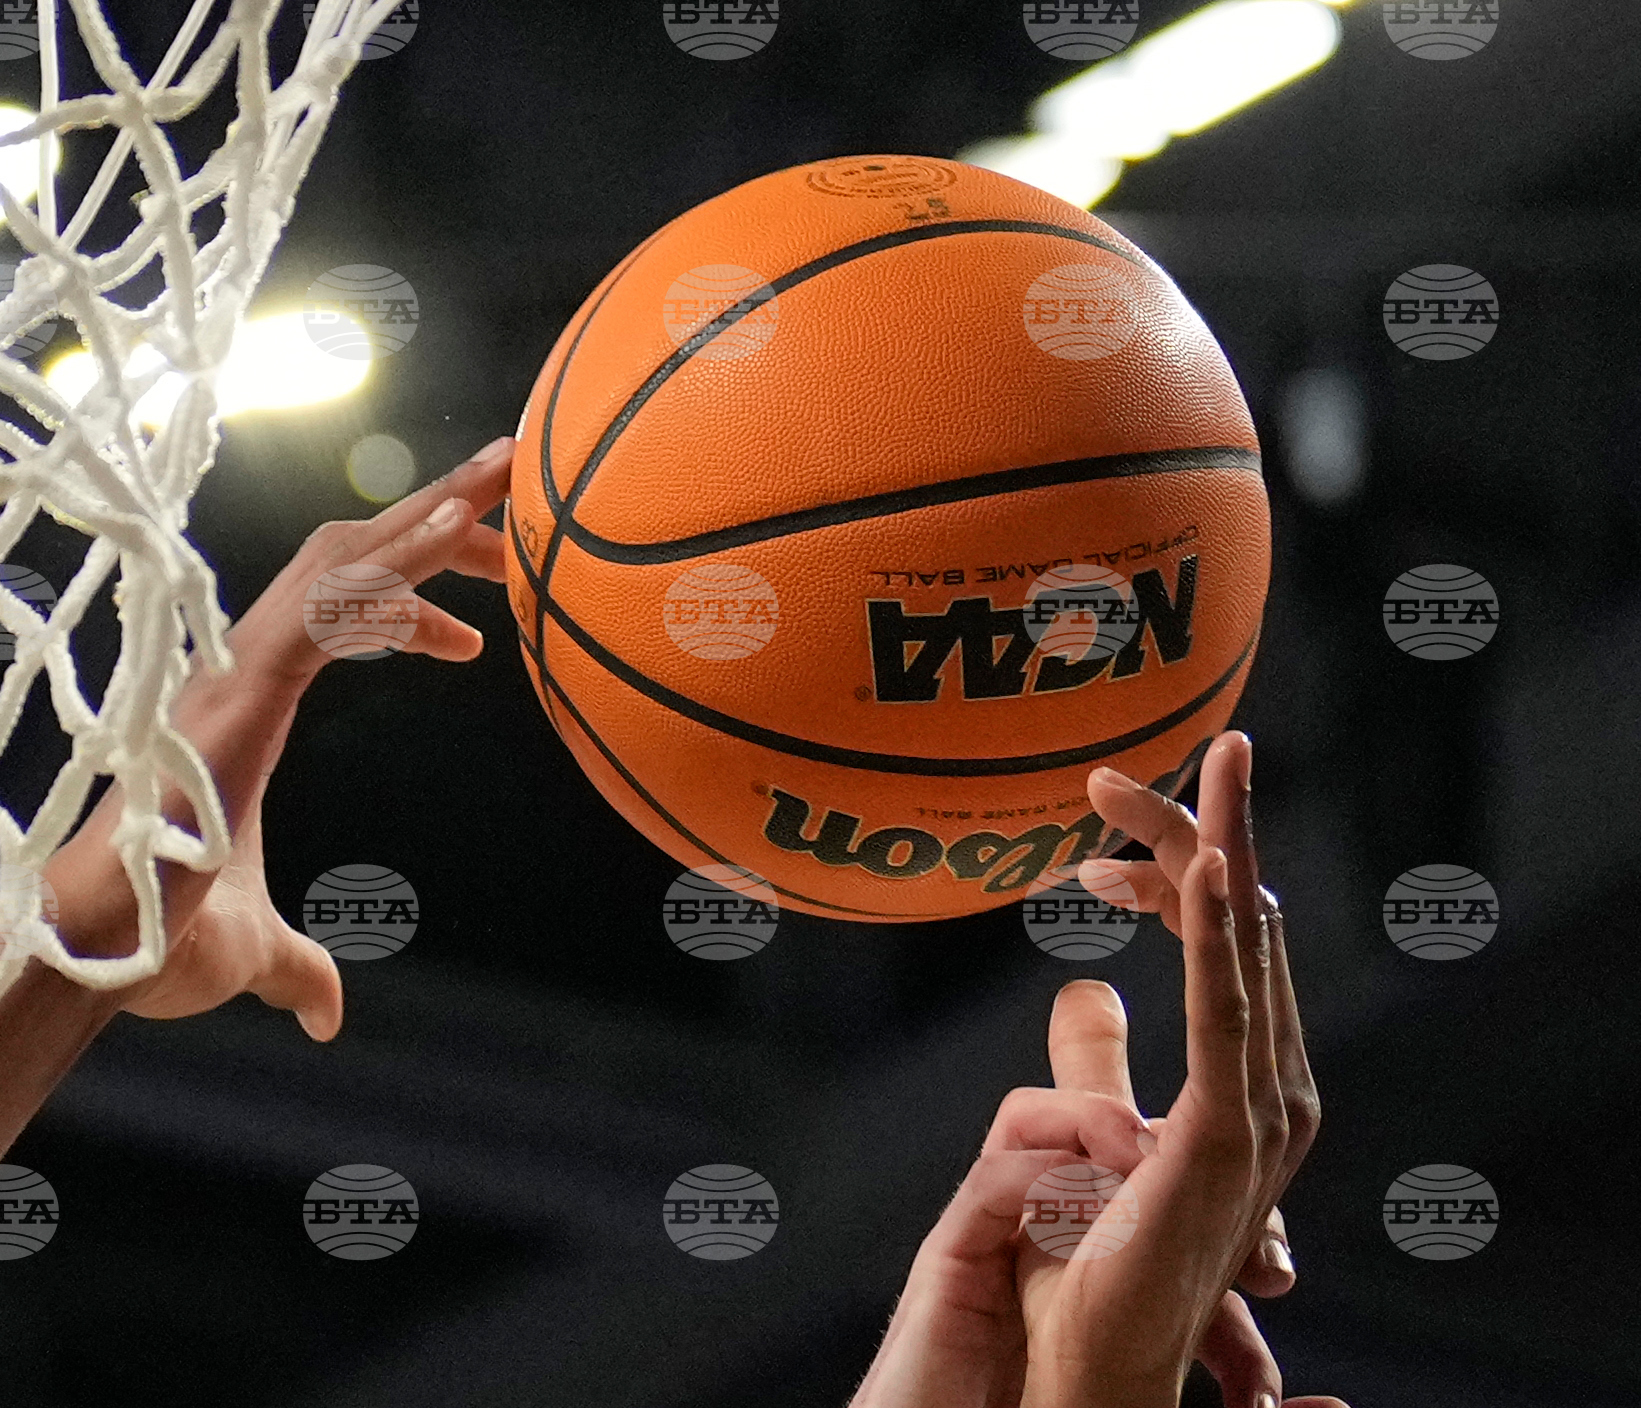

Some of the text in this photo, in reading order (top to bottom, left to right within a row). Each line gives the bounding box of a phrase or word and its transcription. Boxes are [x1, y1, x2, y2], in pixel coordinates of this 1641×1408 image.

[871, 525, 1200, 587] OFFICIAL GAME BALL
[865, 554, 1199, 704] NCAA
